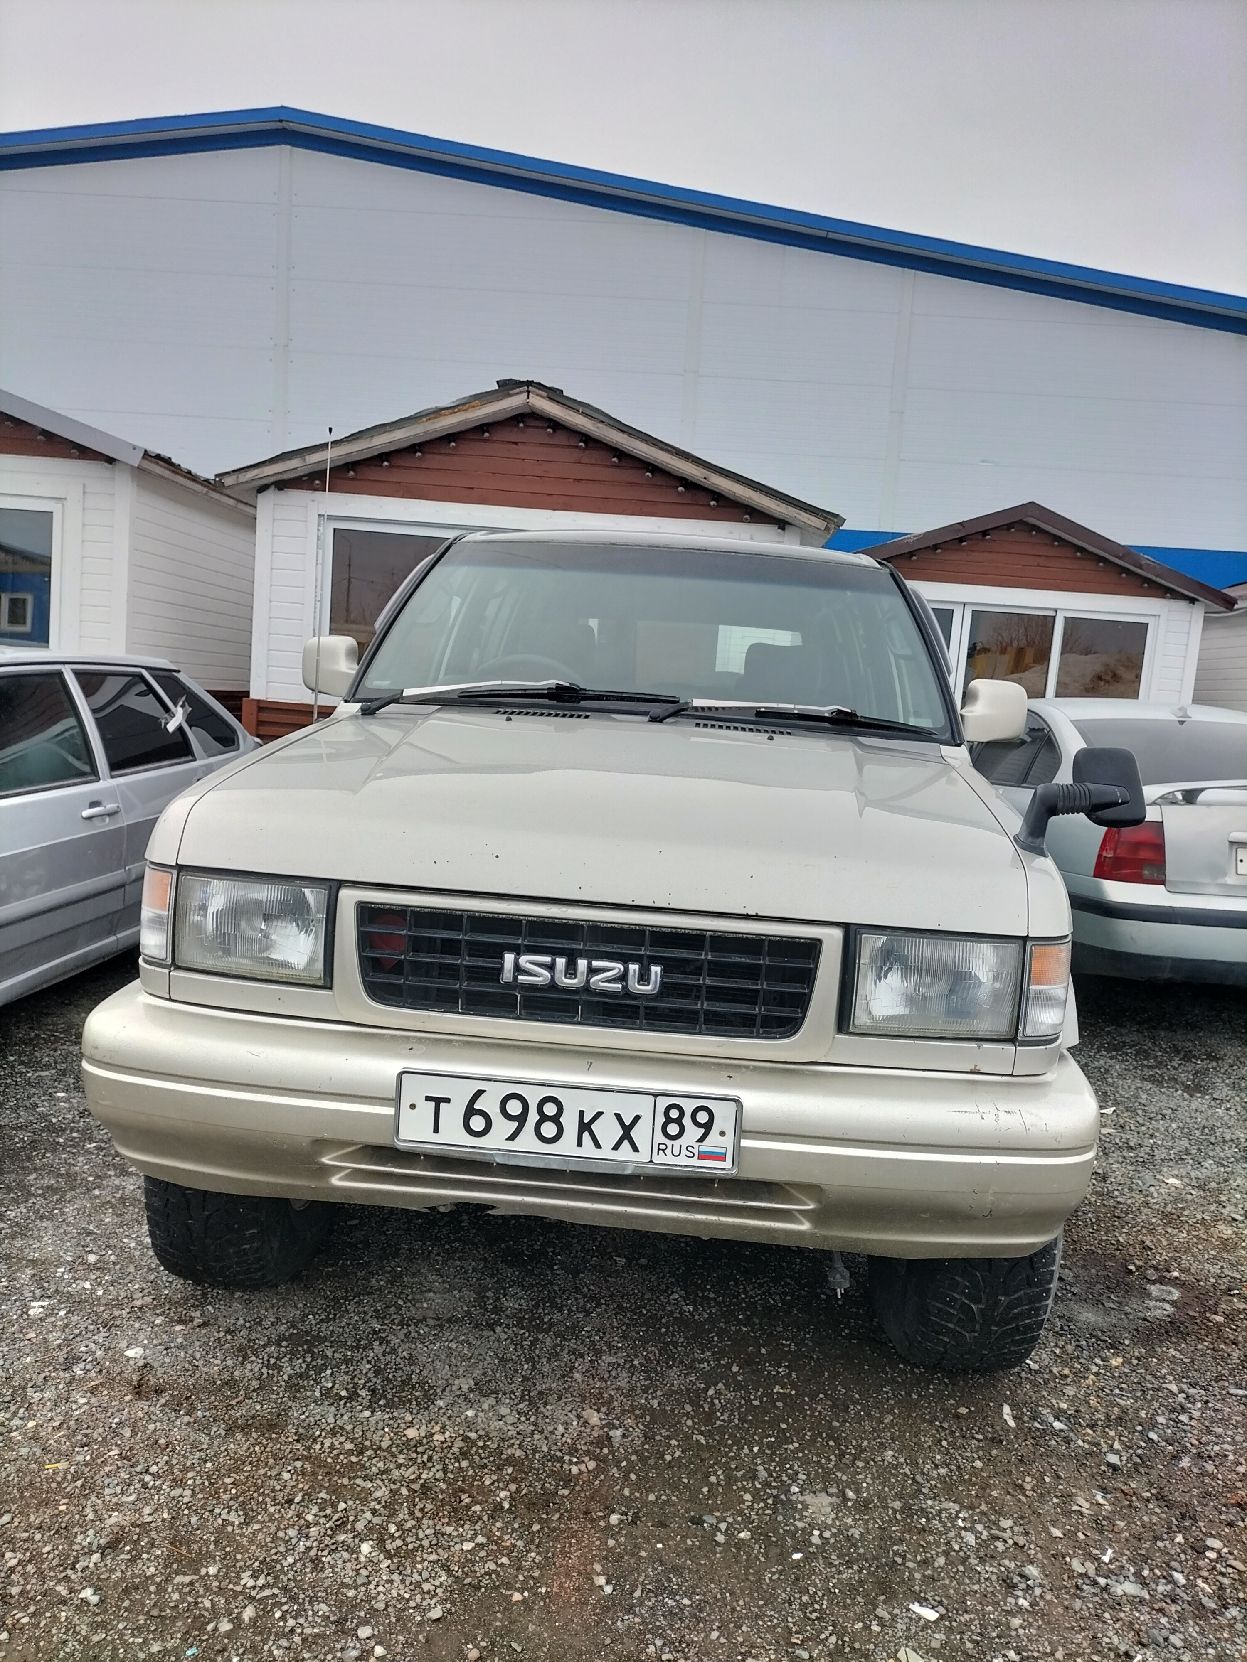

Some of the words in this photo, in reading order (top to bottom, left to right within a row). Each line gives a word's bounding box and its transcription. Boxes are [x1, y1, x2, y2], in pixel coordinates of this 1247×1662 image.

[502, 953, 662, 994] ISUZU
[660, 1103, 715, 1143] 89
[657, 1142, 695, 1159] RUS
